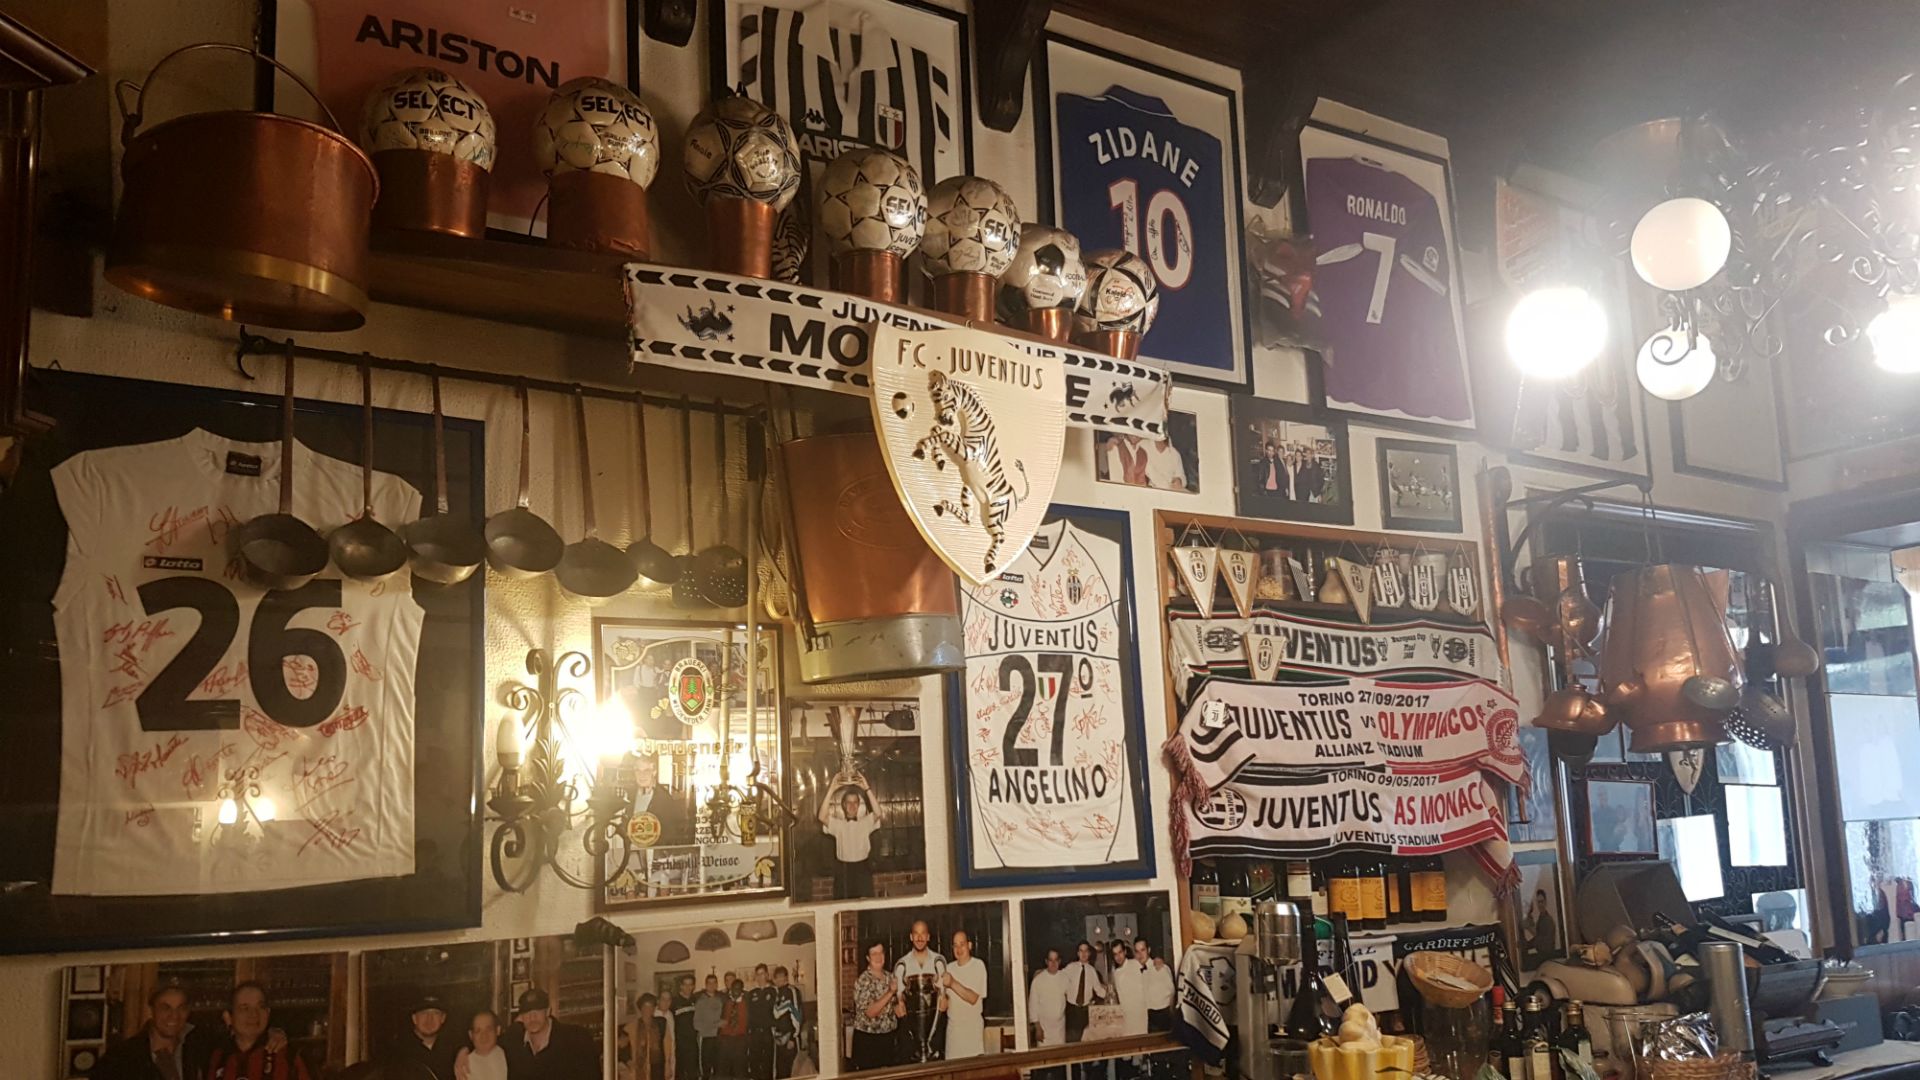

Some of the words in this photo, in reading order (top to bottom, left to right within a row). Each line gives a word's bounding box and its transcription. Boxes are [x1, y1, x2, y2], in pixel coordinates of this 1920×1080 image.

[355, 14, 560, 89] ARISTON
[394, 89, 477, 121] SELECT
[580, 94, 652, 131] SELECT
[1088, 126, 1201, 189] ZIDANE
[1346, 194, 1407, 226] RONALDO
[1107, 178, 1194, 291] 10
[1363, 231, 1397, 325] 7
[949, 346, 1045, 391] JUVENTUS
[987, 615, 1099, 651] JUVENTUS
[135, 574, 348, 733] 26
[1297, 690, 1355, 707] TORINO
[1358, 689, 1430, 708] 27/09/2017
[1315, 741, 1375, 758] ALLIANZ
[988, 764, 1108, 806] ANGELINO
[1331, 768, 1376, 784] TORINO
[1377, 774, 1438, 788] 09/05/2017
[1252, 788, 1383, 830] JUVENTUS
[1394, 795, 1417, 826] AS
[1420, 781, 1486, 825] MONAC
[1332, 830, 1397, 845] JUVENTUS
[1397, 833, 1441, 846] STADIUM
[1403, 937, 1472, 951] CARDIFF
[1472, 931, 1496, 946] 2017
[1184, 986, 1222, 1025] MADRID
